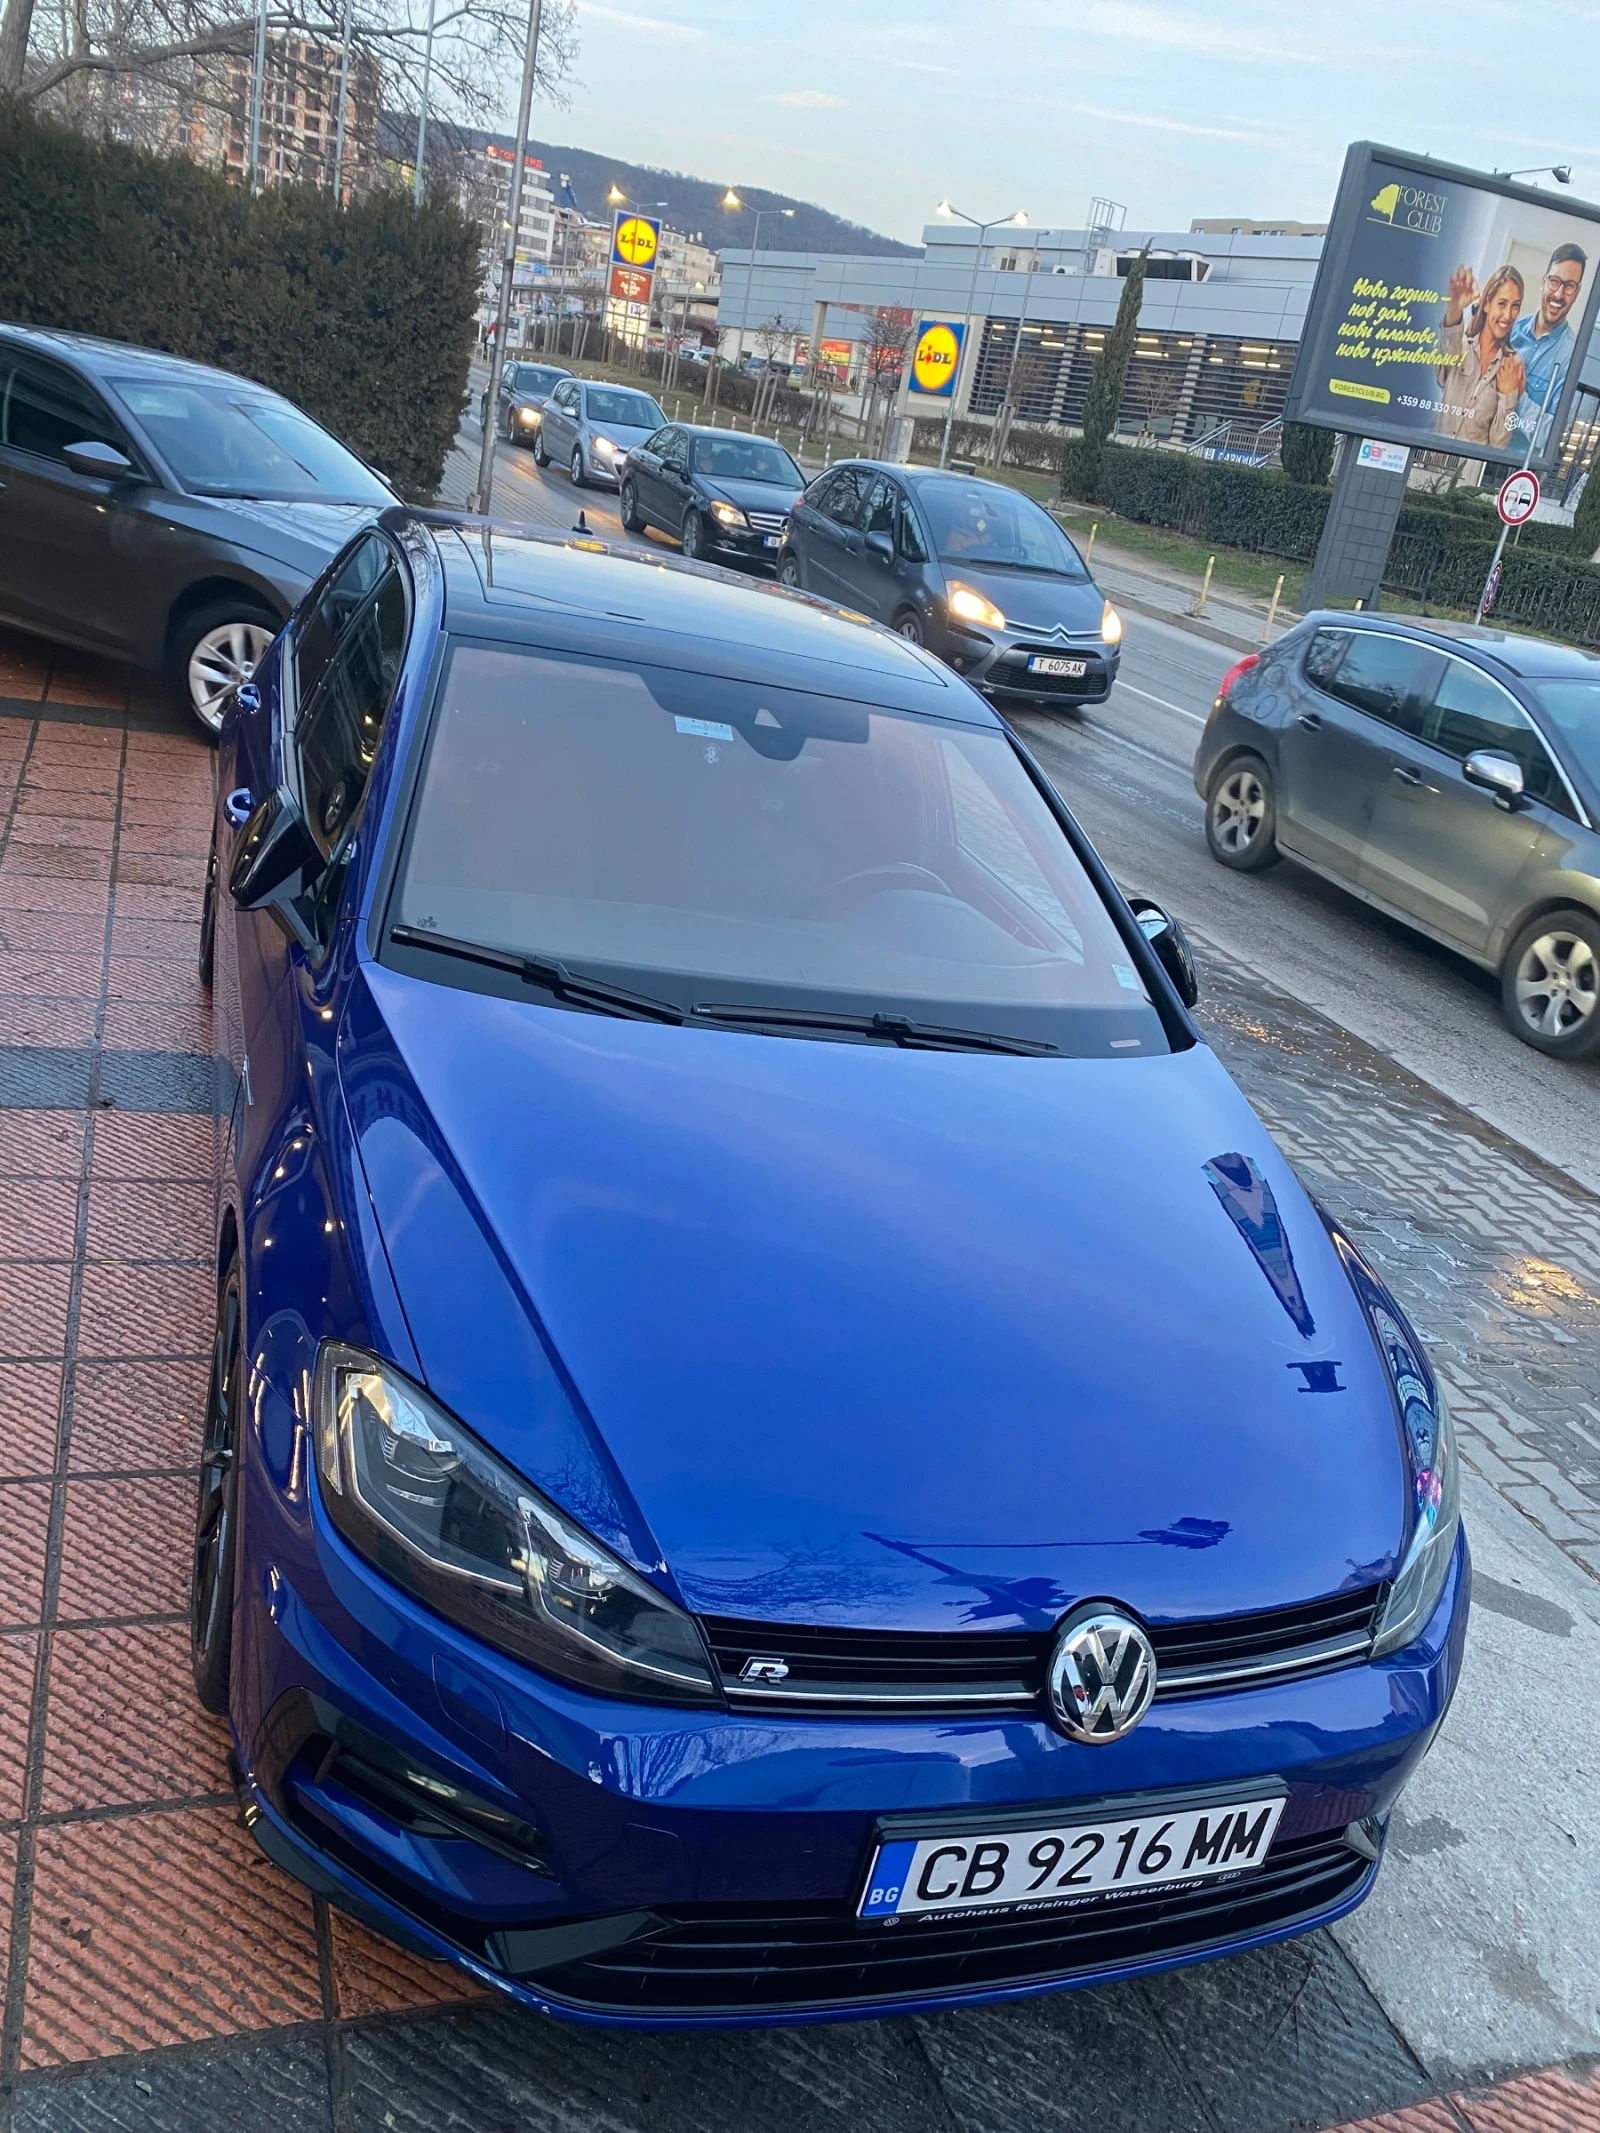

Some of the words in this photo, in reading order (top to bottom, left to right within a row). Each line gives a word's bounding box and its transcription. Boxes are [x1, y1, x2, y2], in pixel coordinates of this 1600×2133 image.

[1397, 185, 1449, 213] FOREST
[1407, 209, 1442, 233] CLUB
[1352, 277, 1389, 300] Нова
[1390, 285, 1439, 308] година
[1348, 301, 1377, 319] нов
[1373, 306, 1412, 326] дом,
[1337, 320, 1373, 339] нови
[1336, 341, 1370, 359] ново
[1372, 346, 1469, 367] изживяване!
[1334, 383, 1386, 399] FORESTCLUB.BG
[1397, 395, 1419, 407] +359
[1419, 398, 1432, 410] 88
[1432, 401, 1450, 414] 330
[1450, 405, 1463, 416] 78
[1463, 408, 1475, 419] 78
[1039, 659, 1045, 670] T
[1048, 660, 1071, 673] 6075
[1071, 662, 1085, 674] AK
[916, 1841, 1010, 1901] CB
[1025, 1821, 1176, 1892] 9216
[1181, 1806, 1273, 1870] MM
[868, 1886, 899, 1905] BG
[918, 1906, 1010, 1922] Autohaus
[1015, 1894, 1100, 1912] Reisinger
[1105, 1880, 1204, 1900] Wasserburg
